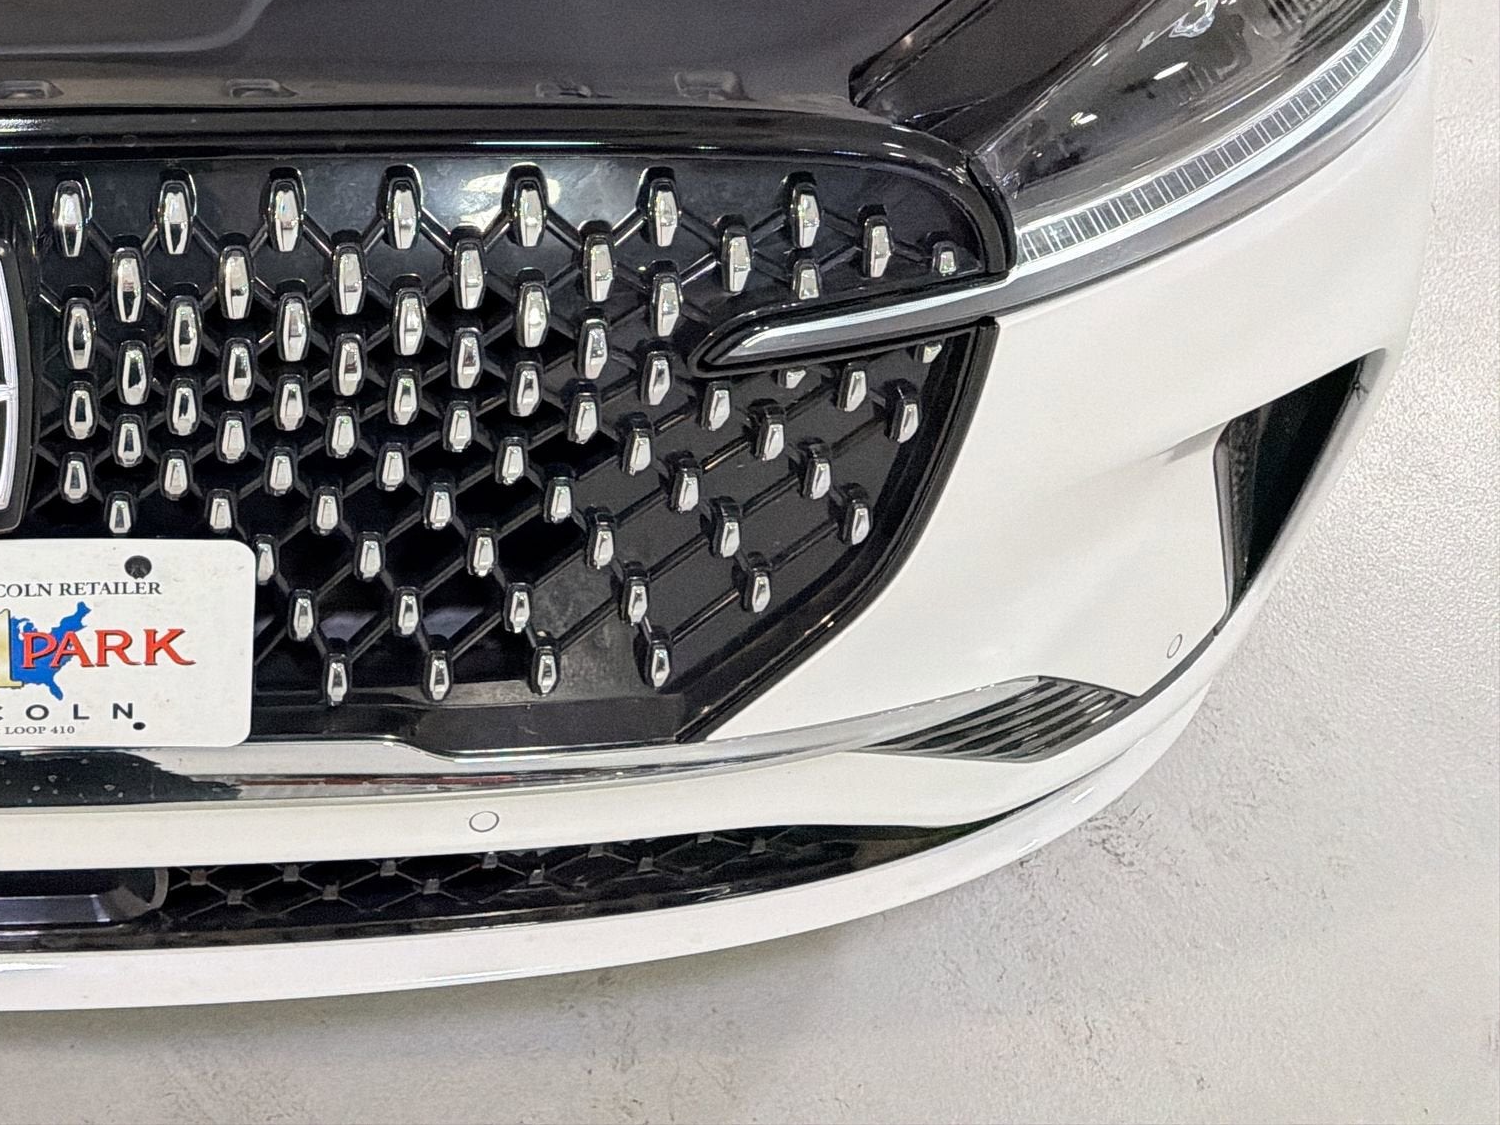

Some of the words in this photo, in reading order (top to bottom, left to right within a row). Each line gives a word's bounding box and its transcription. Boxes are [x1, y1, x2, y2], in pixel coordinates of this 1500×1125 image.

[58, 581, 163, 596] RETAILER
[21, 627, 197, 670] PARK
[4, 725, 47, 735] LOOP
[50, 725, 76, 735] 410
